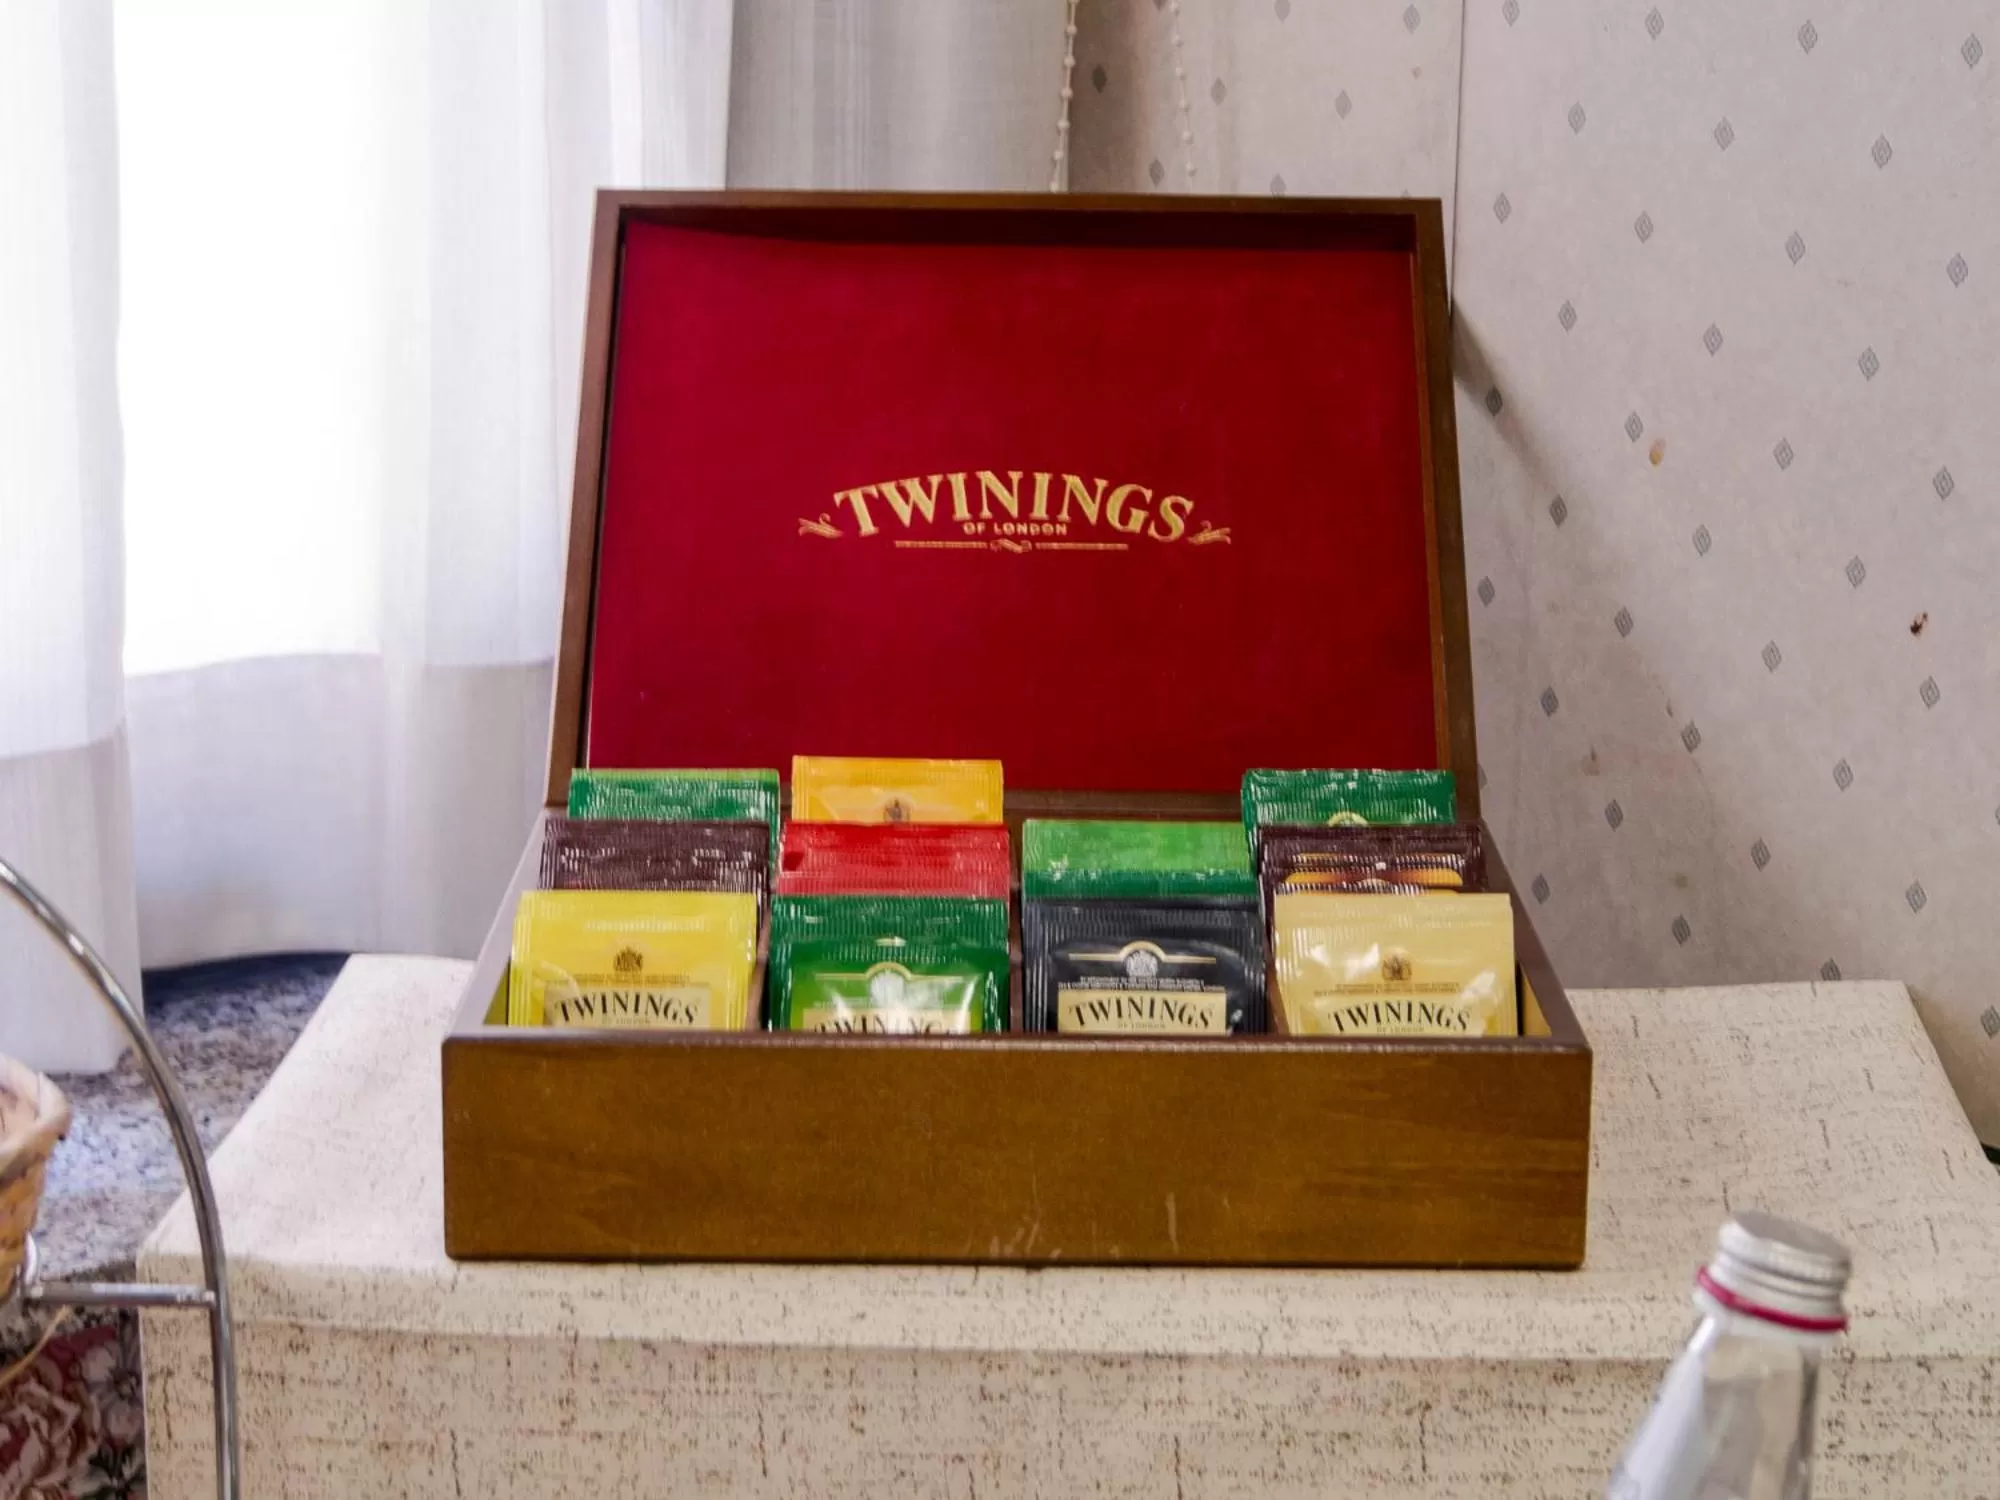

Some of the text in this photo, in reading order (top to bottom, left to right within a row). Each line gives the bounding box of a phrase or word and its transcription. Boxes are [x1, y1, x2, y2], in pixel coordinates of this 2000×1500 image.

[833, 470, 1194, 542] TWININGS
[963, 522, 1067, 536] OF LONDON
[554, 991, 698, 1025] TWININGS
[1068, 995, 1214, 1029] TWININGS
[1328, 1000, 1472, 1032] TWININGS
